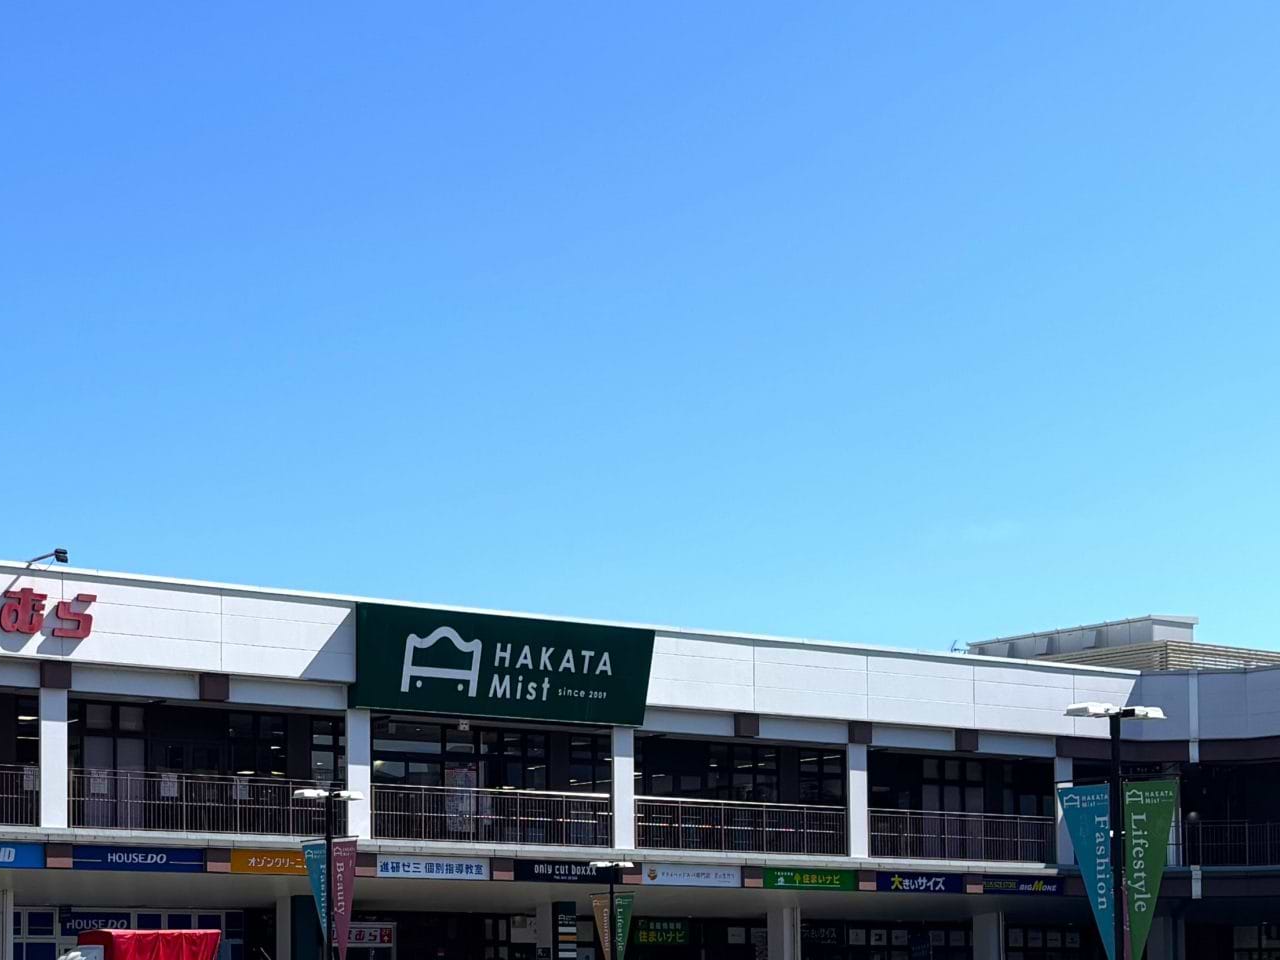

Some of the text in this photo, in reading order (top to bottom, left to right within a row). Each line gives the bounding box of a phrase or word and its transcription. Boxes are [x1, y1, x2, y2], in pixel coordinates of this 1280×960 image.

[494, 642, 613, 676] HAKATA
[489, 674, 550, 701] Mist
[558, 687, 585, 698] since
[248, 857, 307, 868] オゾンクリーニ
[534, 864, 553, 874] only
[555, 865, 569, 875] cut
[1095, 815, 1109, 910] Fashion
[1128, 812, 1151, 912] Lifestyle
[334, 862, 345, 915] Beauty
[890, 874, 946, 891] 大きいサイズ
